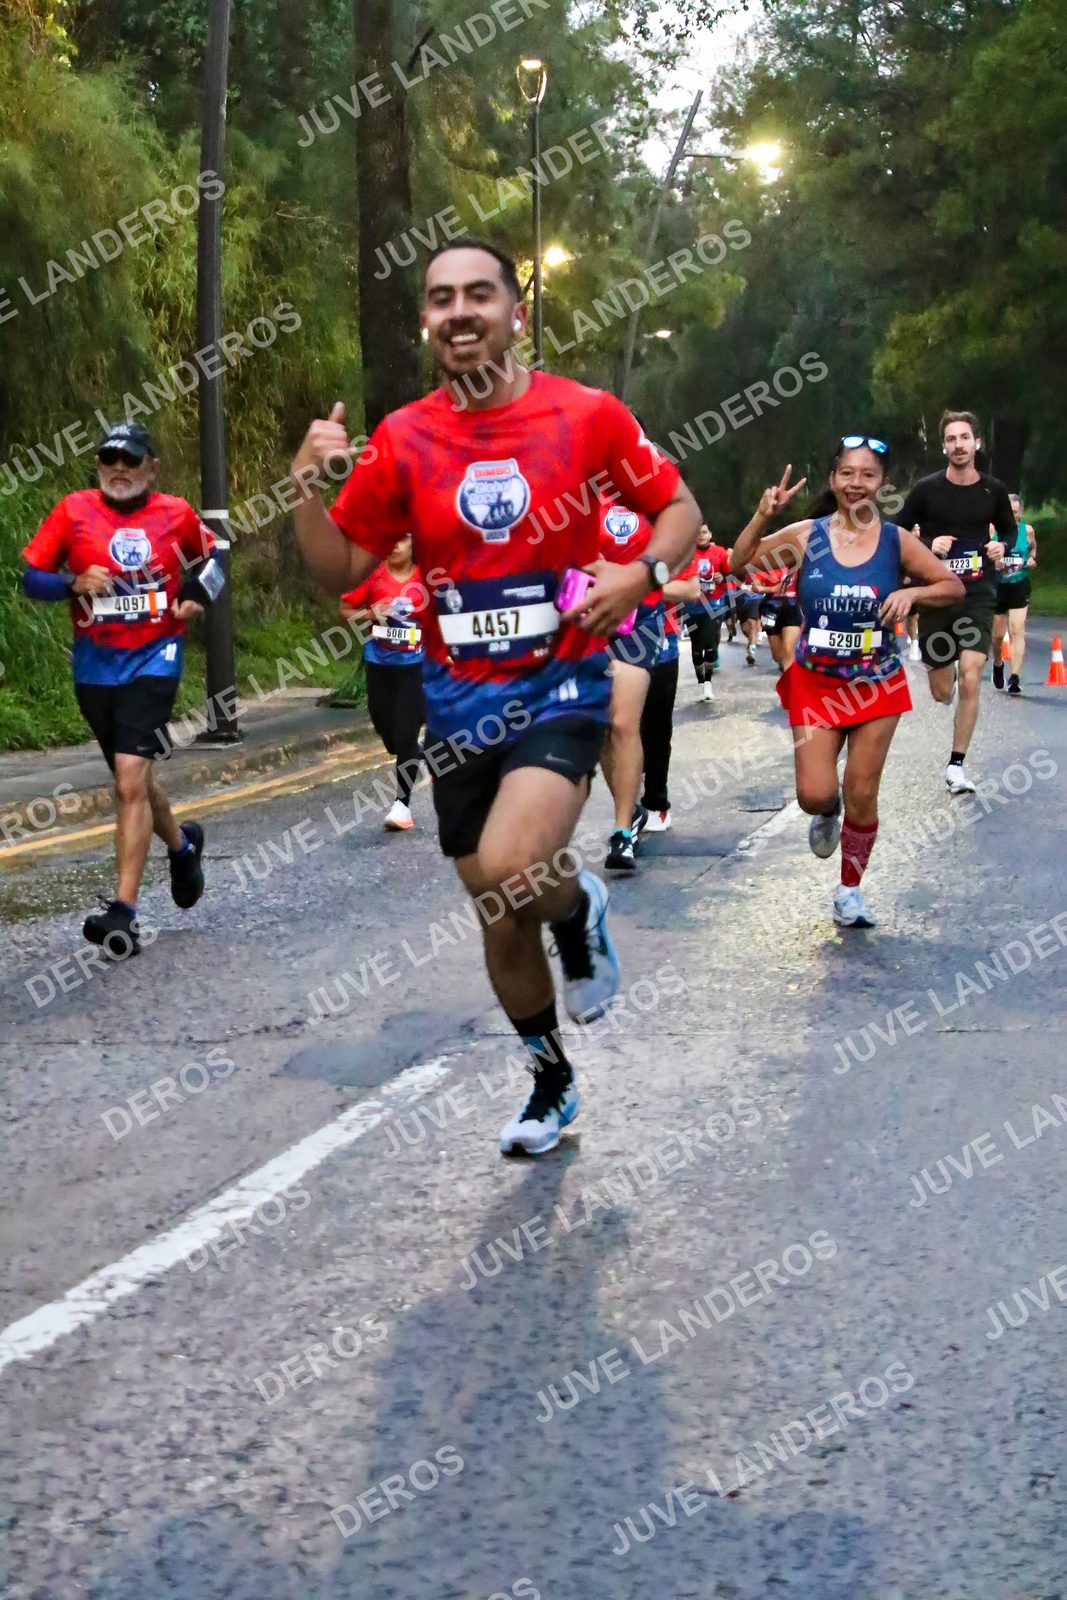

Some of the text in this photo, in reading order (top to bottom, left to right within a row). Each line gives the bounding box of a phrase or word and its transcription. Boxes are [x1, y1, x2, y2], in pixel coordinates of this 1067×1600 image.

[949, 558, 970, 569] 4223
[830, 584, 879, 599] JMA
[115, 596, 145, 611] 4097
[472, 609, 520, 638] 4457
[829, 632, 862, 648] 5290
